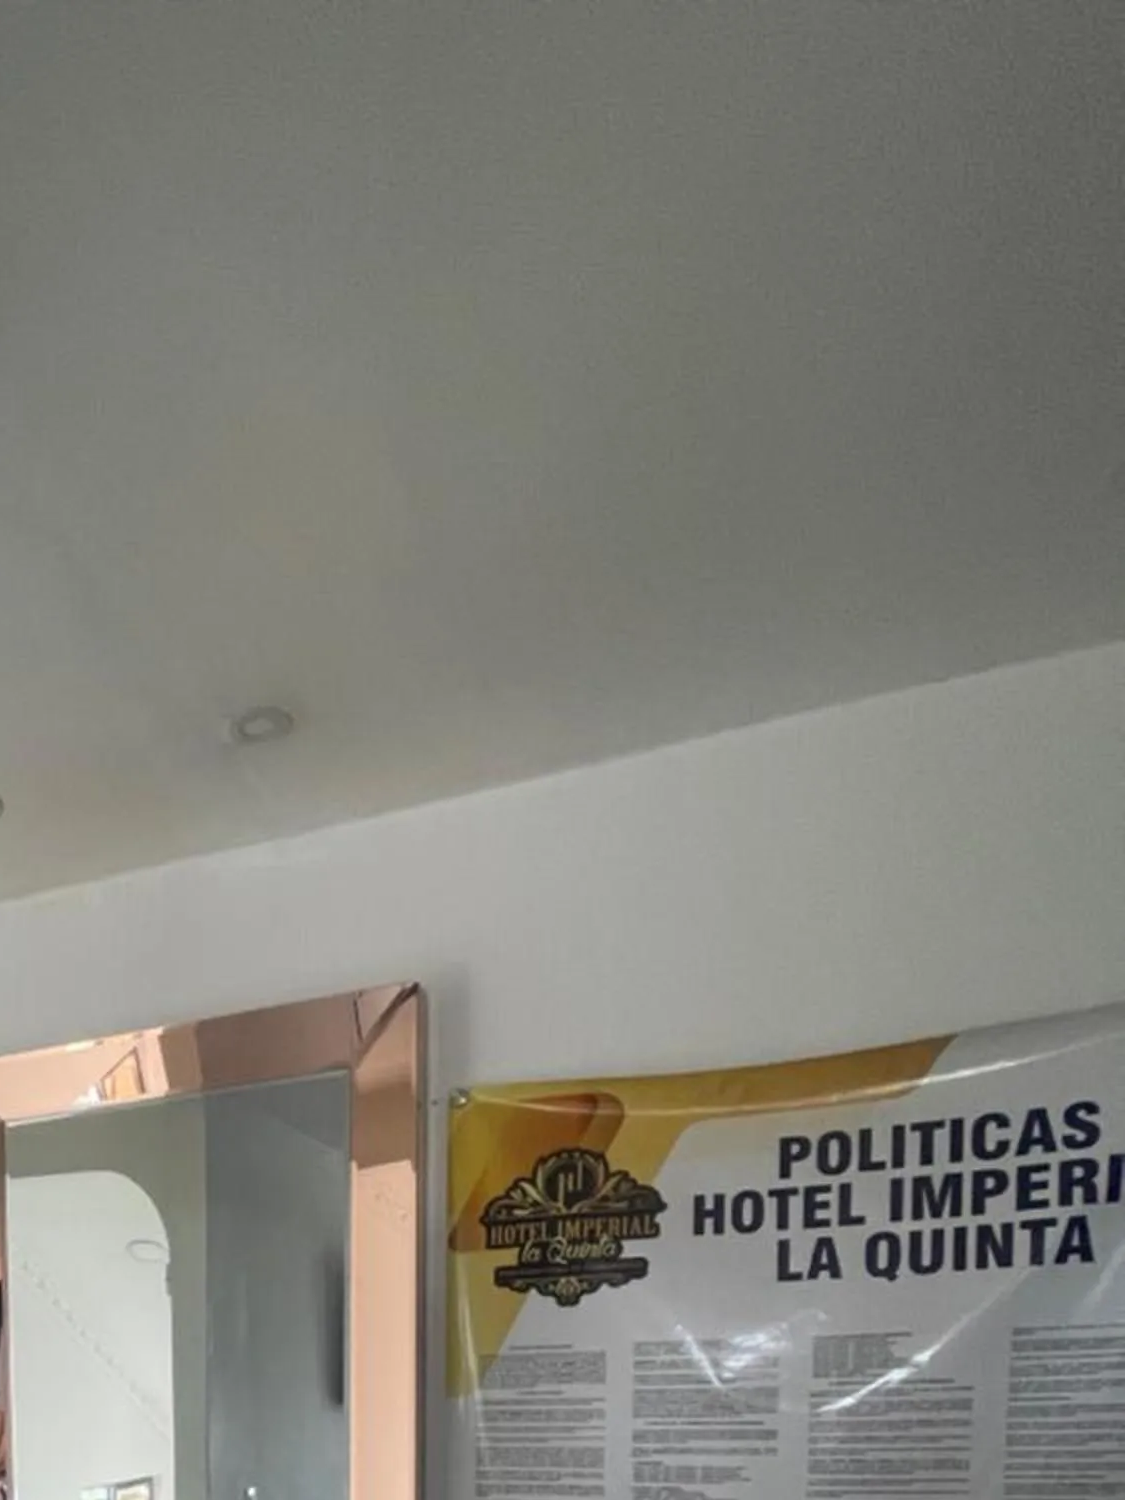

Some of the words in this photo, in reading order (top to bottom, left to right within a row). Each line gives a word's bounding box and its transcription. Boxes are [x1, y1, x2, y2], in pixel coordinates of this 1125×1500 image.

[779, 1101, 1101, 1179] POLITICAS
[490, 1223, 547, 1246] HOTEL
[558, 1215, 656, 1241] IMPERIAL
[693, 1182, 866, 1236] HOTEL
[889, 1153, 1125, 1222] IMPERI
[777, 1237, 842, 1282] LA
[865, 1215, 1095, 1281] QUINTA
